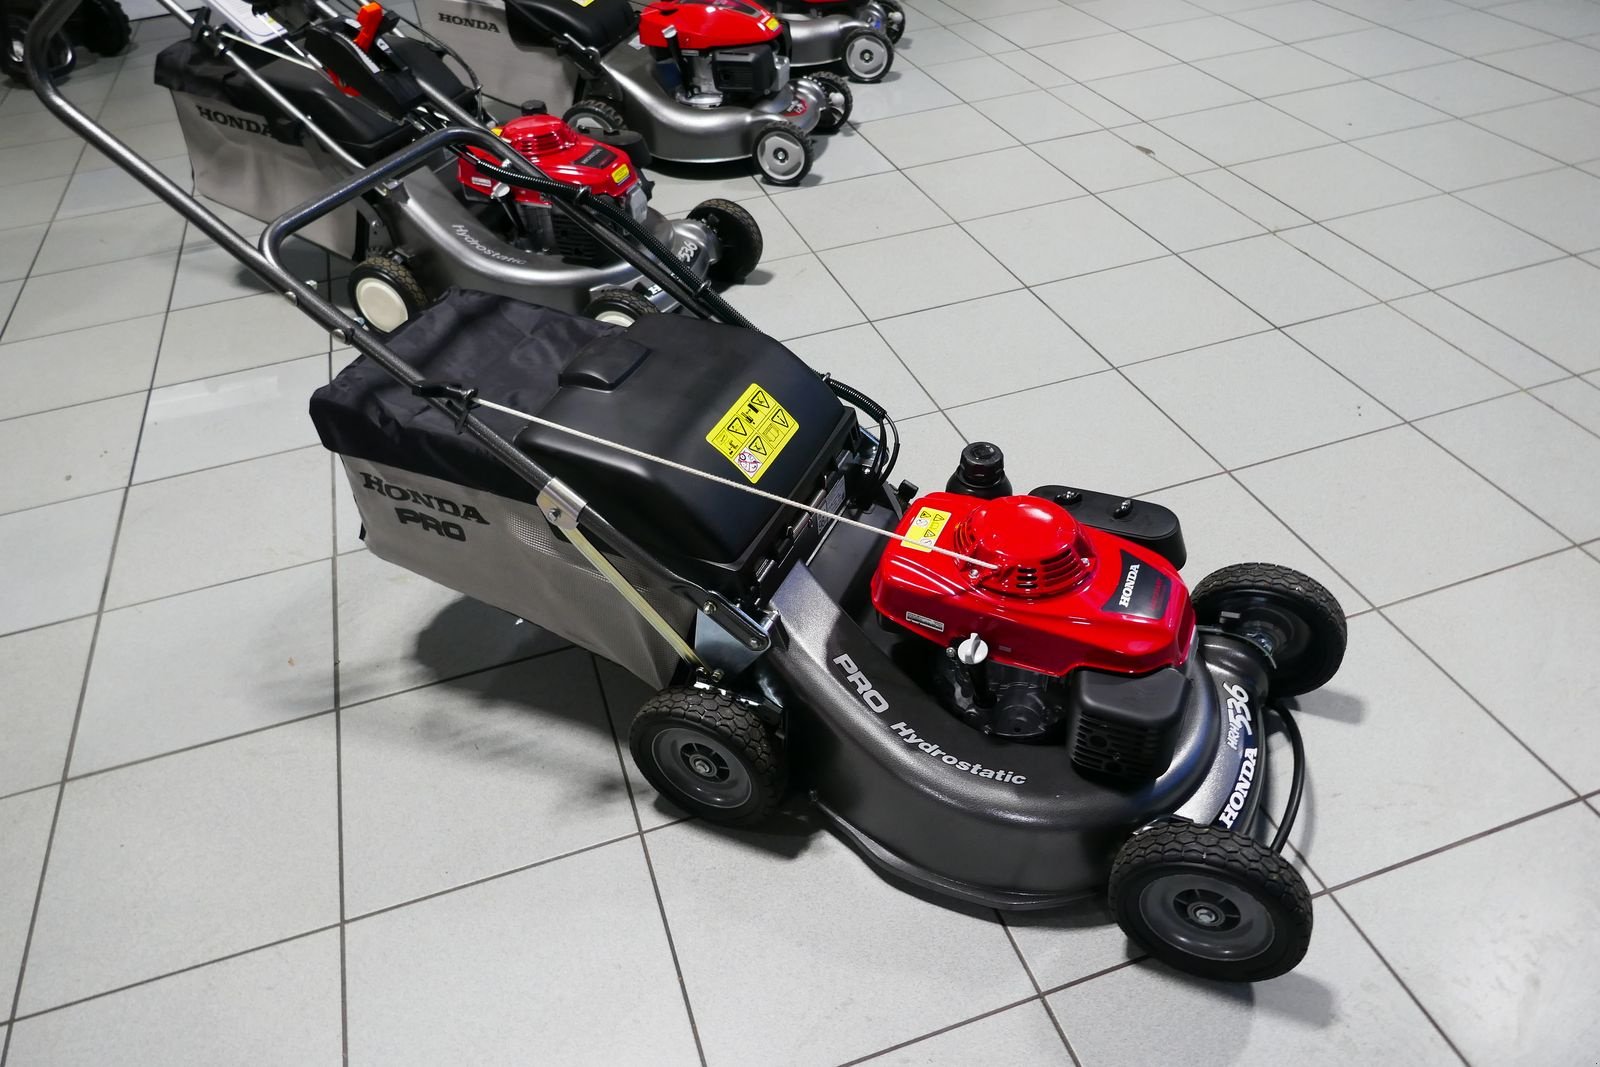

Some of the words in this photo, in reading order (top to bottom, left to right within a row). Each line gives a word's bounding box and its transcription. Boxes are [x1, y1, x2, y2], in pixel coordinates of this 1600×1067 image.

[438, 12, 500, 33] HONDA
[451, 224, 528, 265] Hydrostatic
[359, 472, 491, 525] HONDA
[394, 507, 466, 542] PRO
[1118, 564, 1140, 608] HONDA
[833, 653, 890, 714] PRO
[890, 721, 1027, 785] Hydrostatic
[1218, 747, 1258, 830] HONDA
